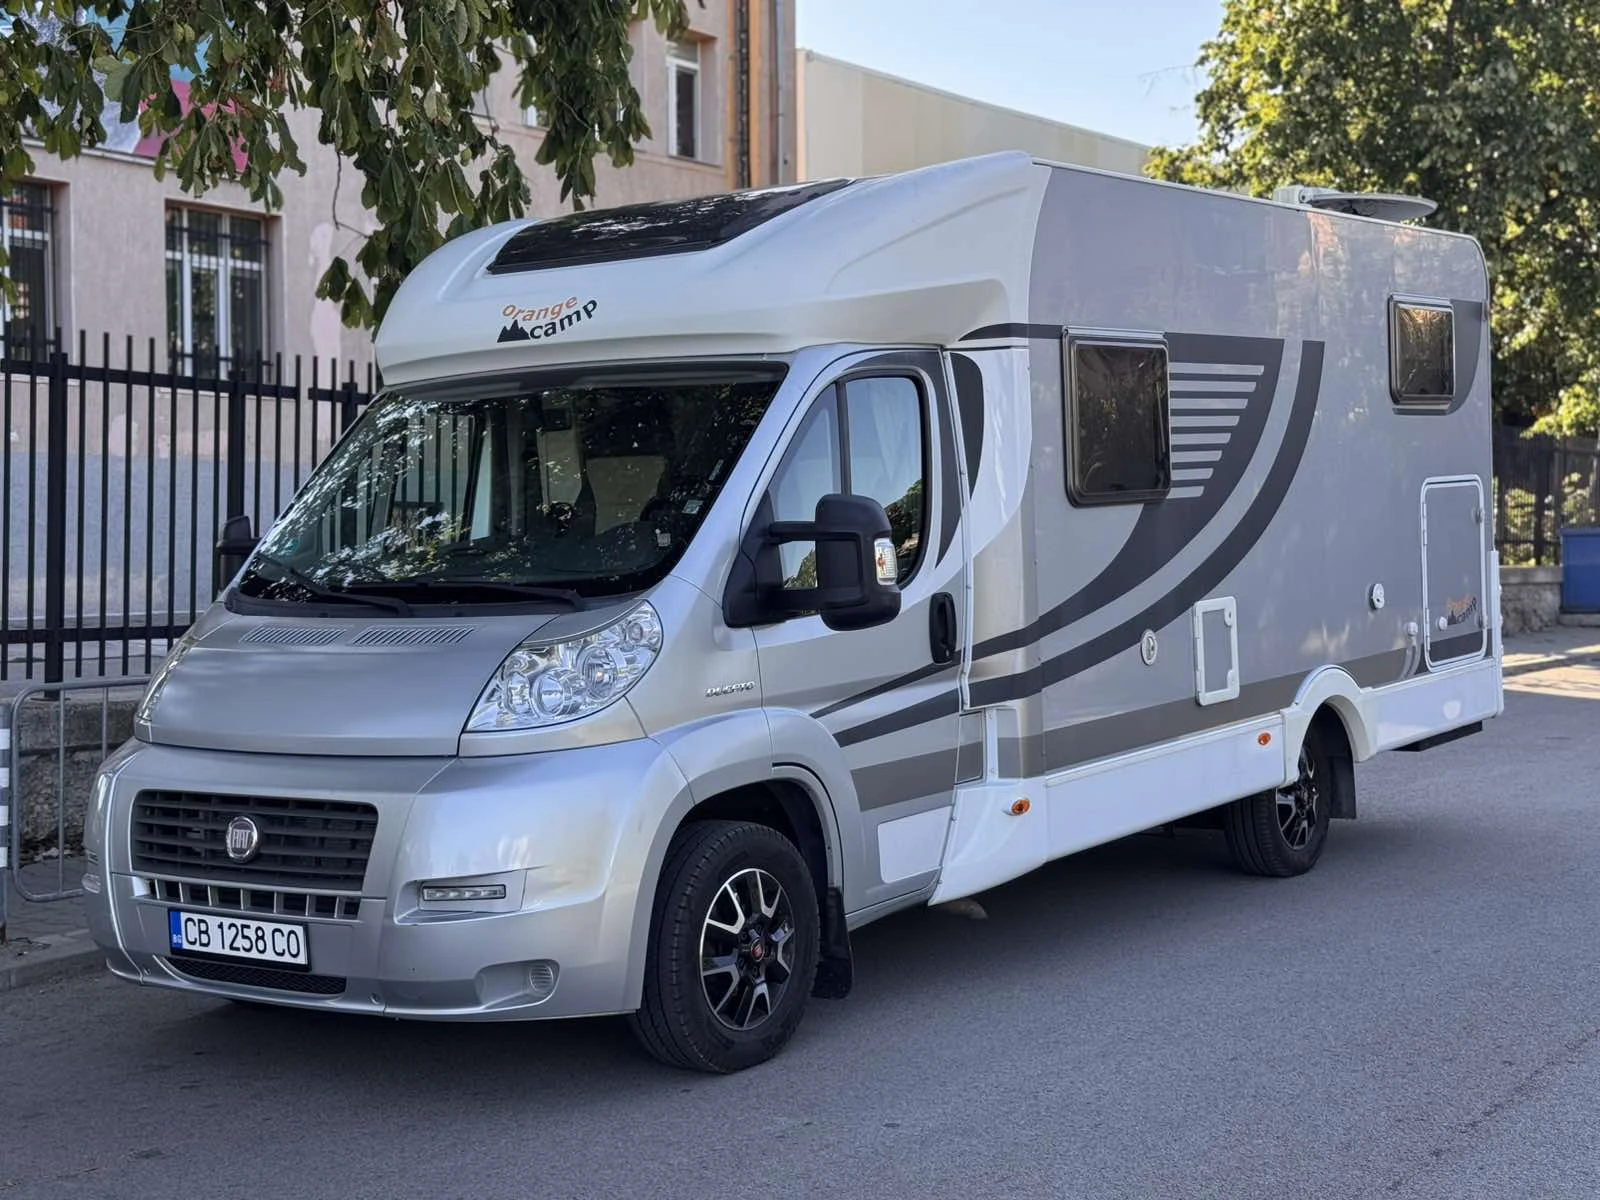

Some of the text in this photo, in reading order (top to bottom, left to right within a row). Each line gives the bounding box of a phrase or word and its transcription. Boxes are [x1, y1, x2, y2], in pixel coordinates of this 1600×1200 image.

[502, 296, 578, 321] orange
[529, 299, 598, 339] camp
[232, 829, 251, 848] FIAT
[184, 917, 300, 958] CB 1258 CO
